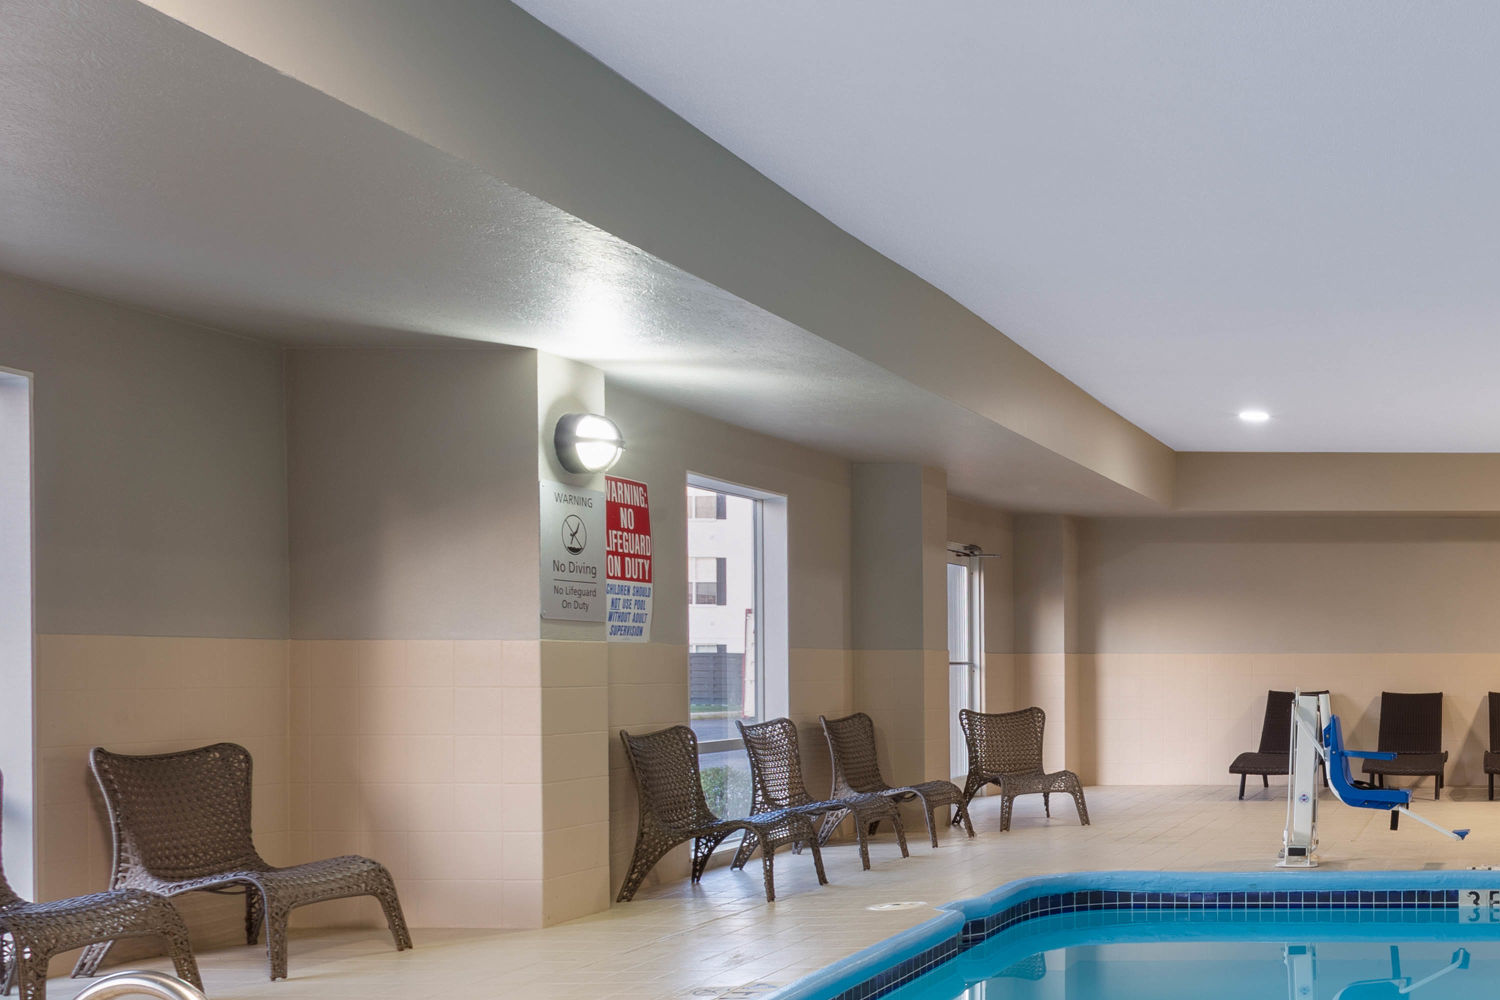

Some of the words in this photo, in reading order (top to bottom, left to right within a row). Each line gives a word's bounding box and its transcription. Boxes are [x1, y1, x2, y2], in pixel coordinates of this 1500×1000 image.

[554, 491, 592, 508] WARNING
[620, 507, 634, 529] NO
[553, 560, 565, 573] No
[569, 561, 596, 578] Diving
[608, 555, 621, 577] ON
[625, 557, 650, 580] DUTY
[554, 585, 564, 595] No
[565, 586, 596, 599] Lifeguard
[606, 583, 630, 596] CHILDREN
[632, 585, 651, 598] SHOULD
[561, 600, 572, 609] On
[573, 600, 589, 612] Duty
[610, 597, 621, 609] NOT
[622, 598, 632, 610] USE
[633, 599, 646, 611] POOL
[608, 611, 631, 622] WITHOUT
[632, 612, 648, 624] ADULT
[609, 625, 644, 636] SUPERVISION
